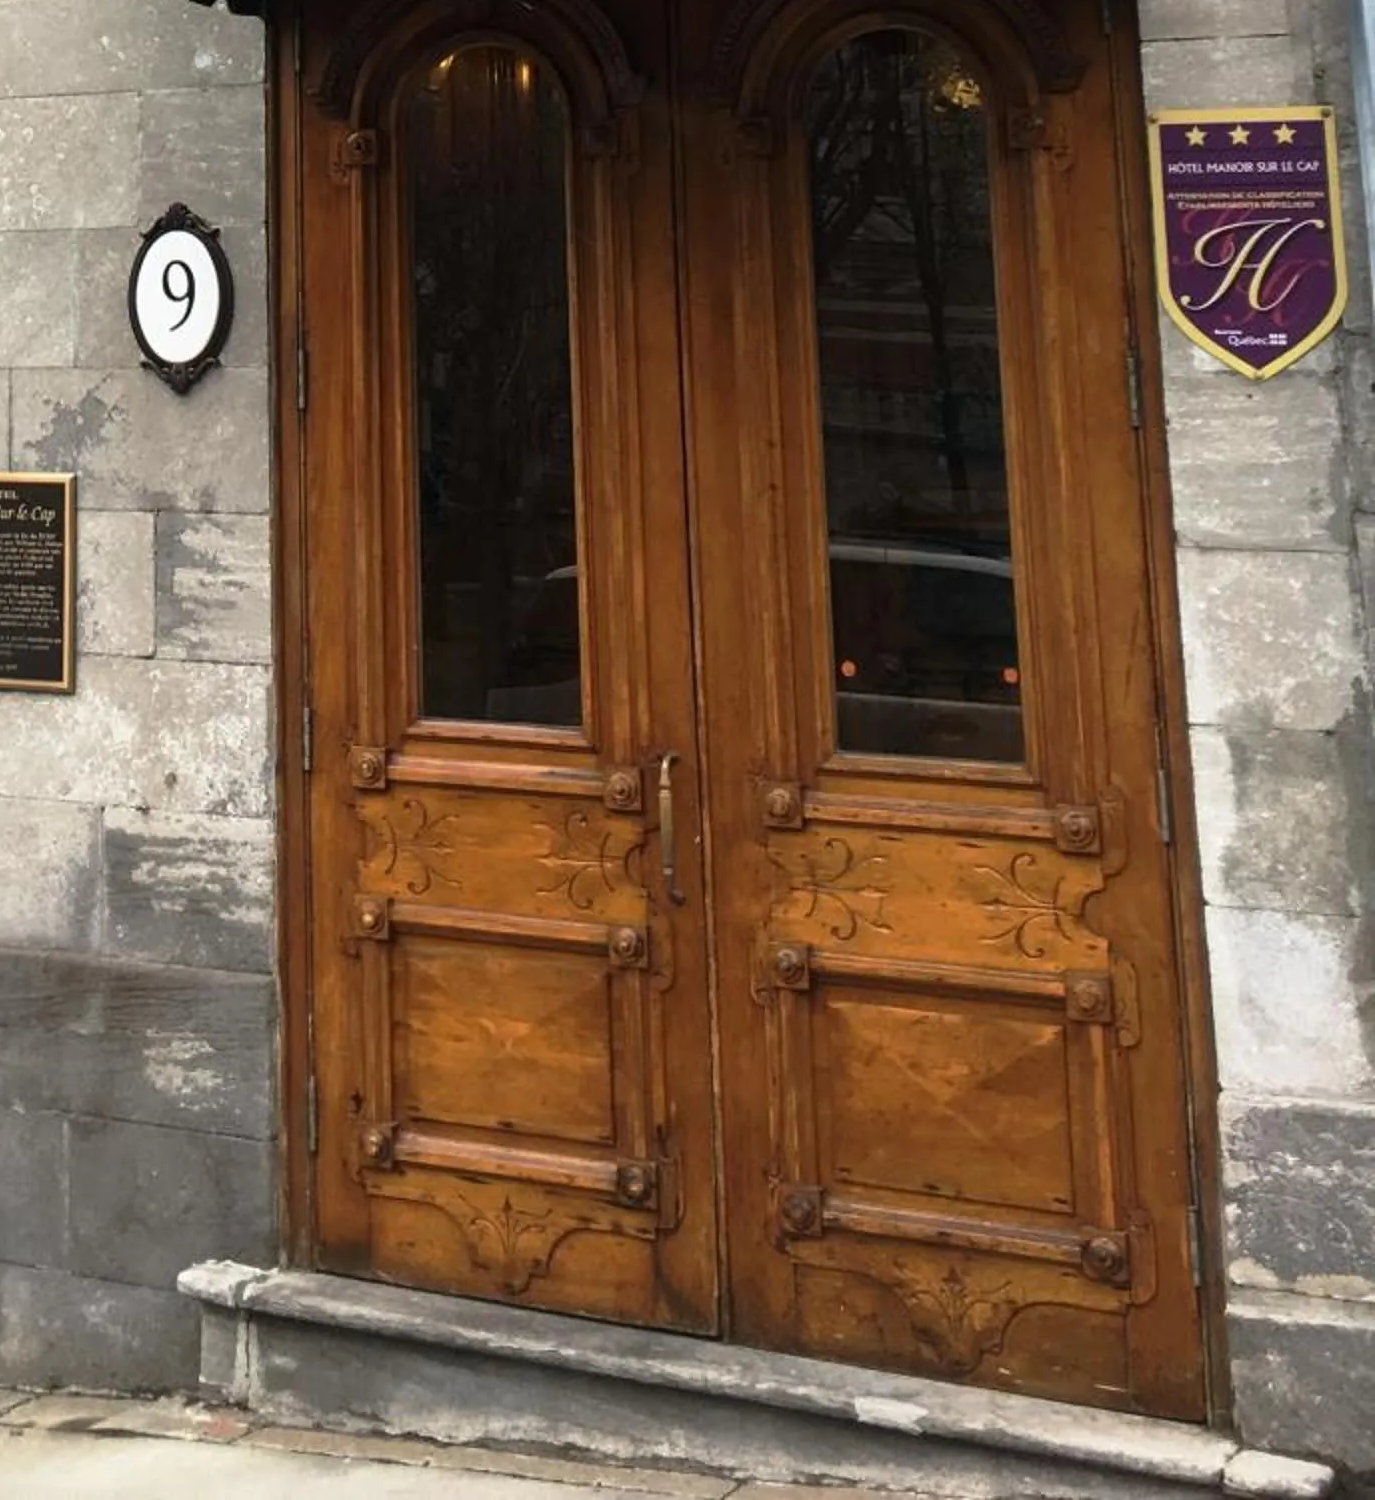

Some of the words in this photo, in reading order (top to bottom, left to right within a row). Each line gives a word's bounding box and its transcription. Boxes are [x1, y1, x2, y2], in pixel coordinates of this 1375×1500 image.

[1206, 161, 1253, 173] MANOIR
[1256, 161, 1278, 173] SUR
[1281, 161, 1294, 173] LE
[1296, 160, 1321, 172] CAP
[161, 259, 196, 332] 9
[30, 506, 56, 526] Cap
